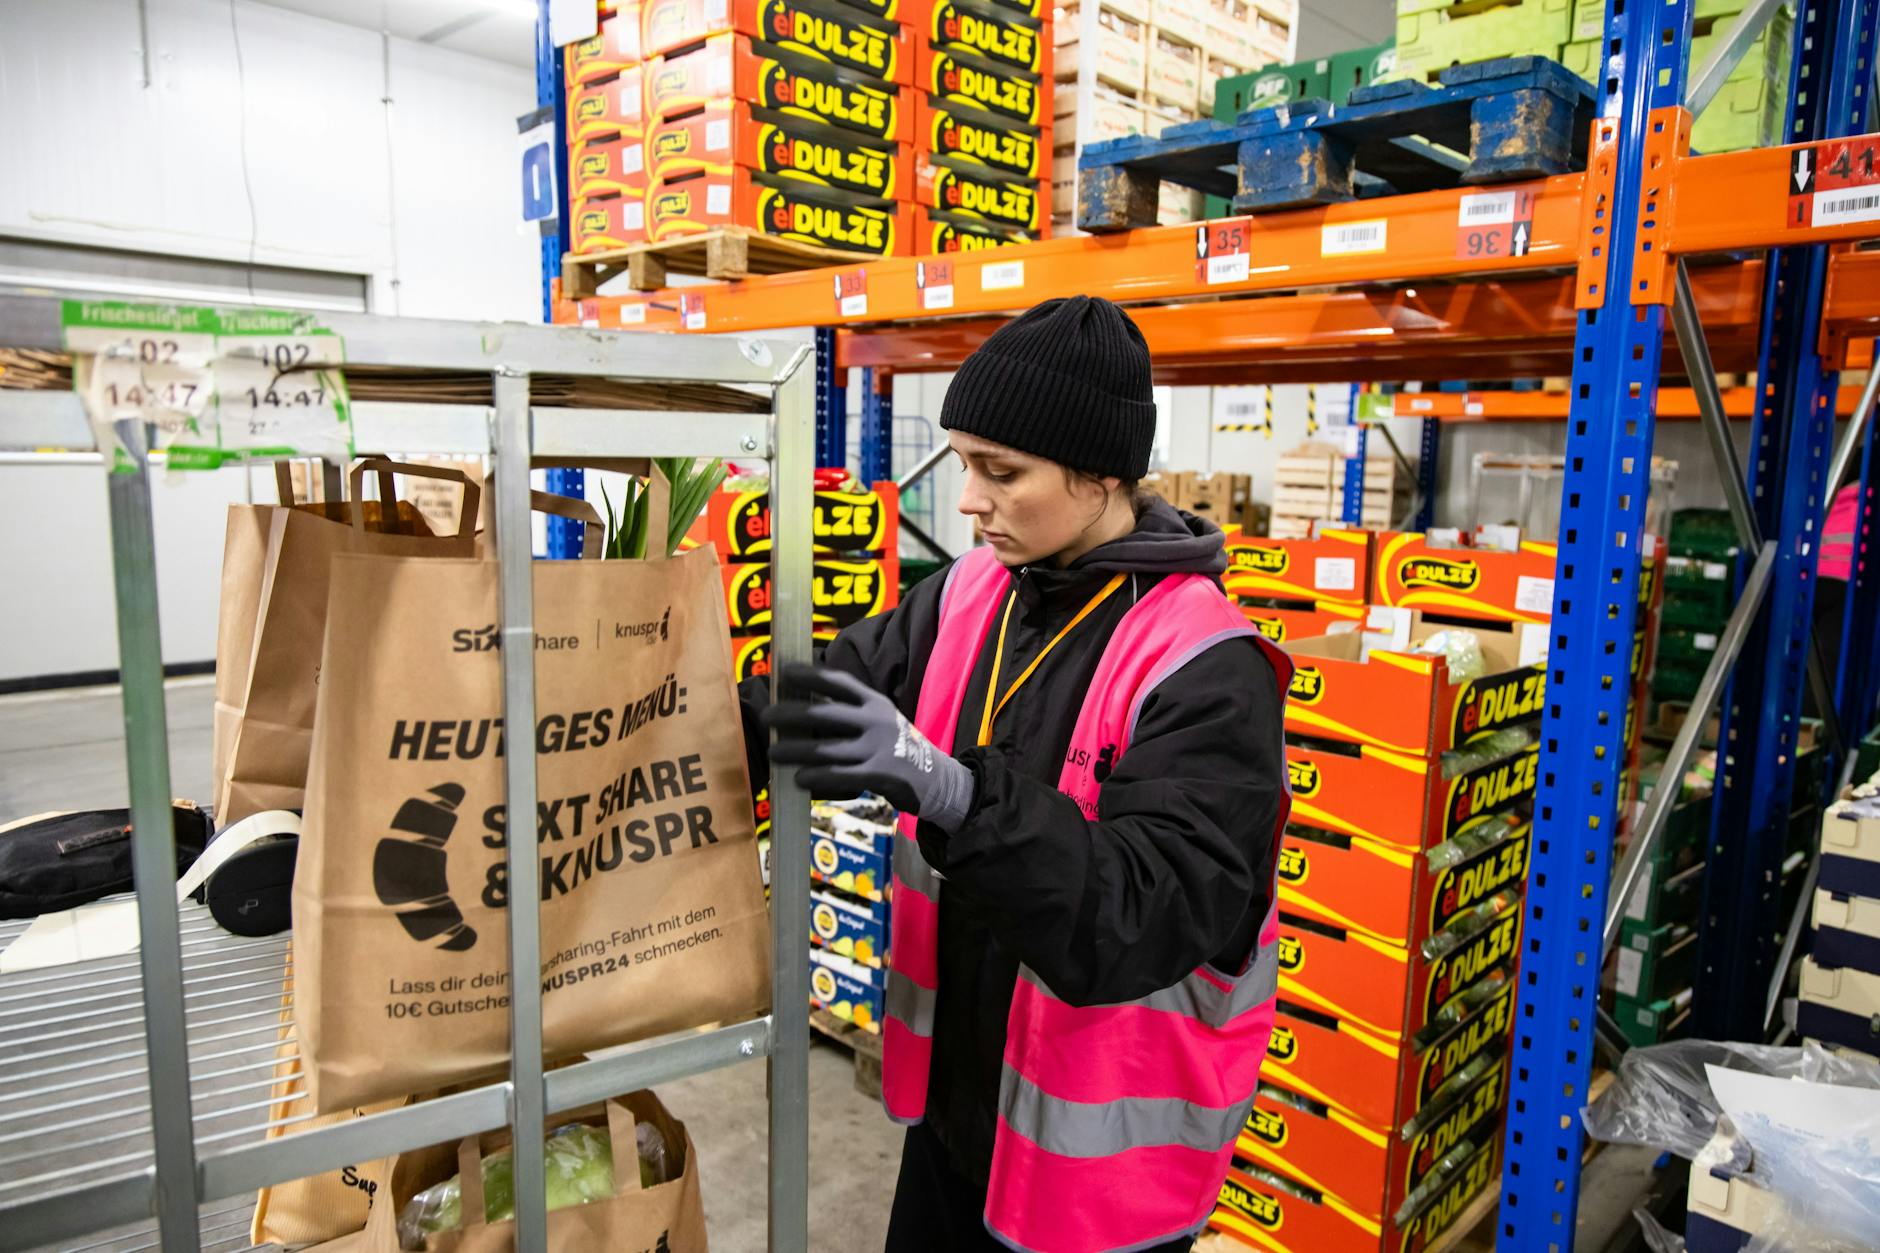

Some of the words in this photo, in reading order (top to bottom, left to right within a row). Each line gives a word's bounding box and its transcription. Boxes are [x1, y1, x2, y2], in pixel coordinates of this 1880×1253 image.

[1829, 146, 1874, 179] 41
[1216, 228, 1243, 251] 35
[1467, 230, 1502, 256] 36
[931, 266, 948, 282] 34
[534, 633, 580, 650] hare
[615, 621, 660, 639] knuspr
[388, 707, 615, 761] HEUTGES
[616, 672, 688, 742] MENÜ:
[482, 793, 592, 850] SXT
[595, 753, 708, 826] SHARE
[541, 805, 720, 901] KNUSPR
[385, 1001, 423, 1020] 10€
[540, 953, 631, 997] NUSPR24
[633, 926, 724, 965] schmecken.
[389, 978, 436, 995] Lass
[440, 975, 466, 993] dir
[657, 915, 682, 935] mit
[684, 905, 717, 927] dem
